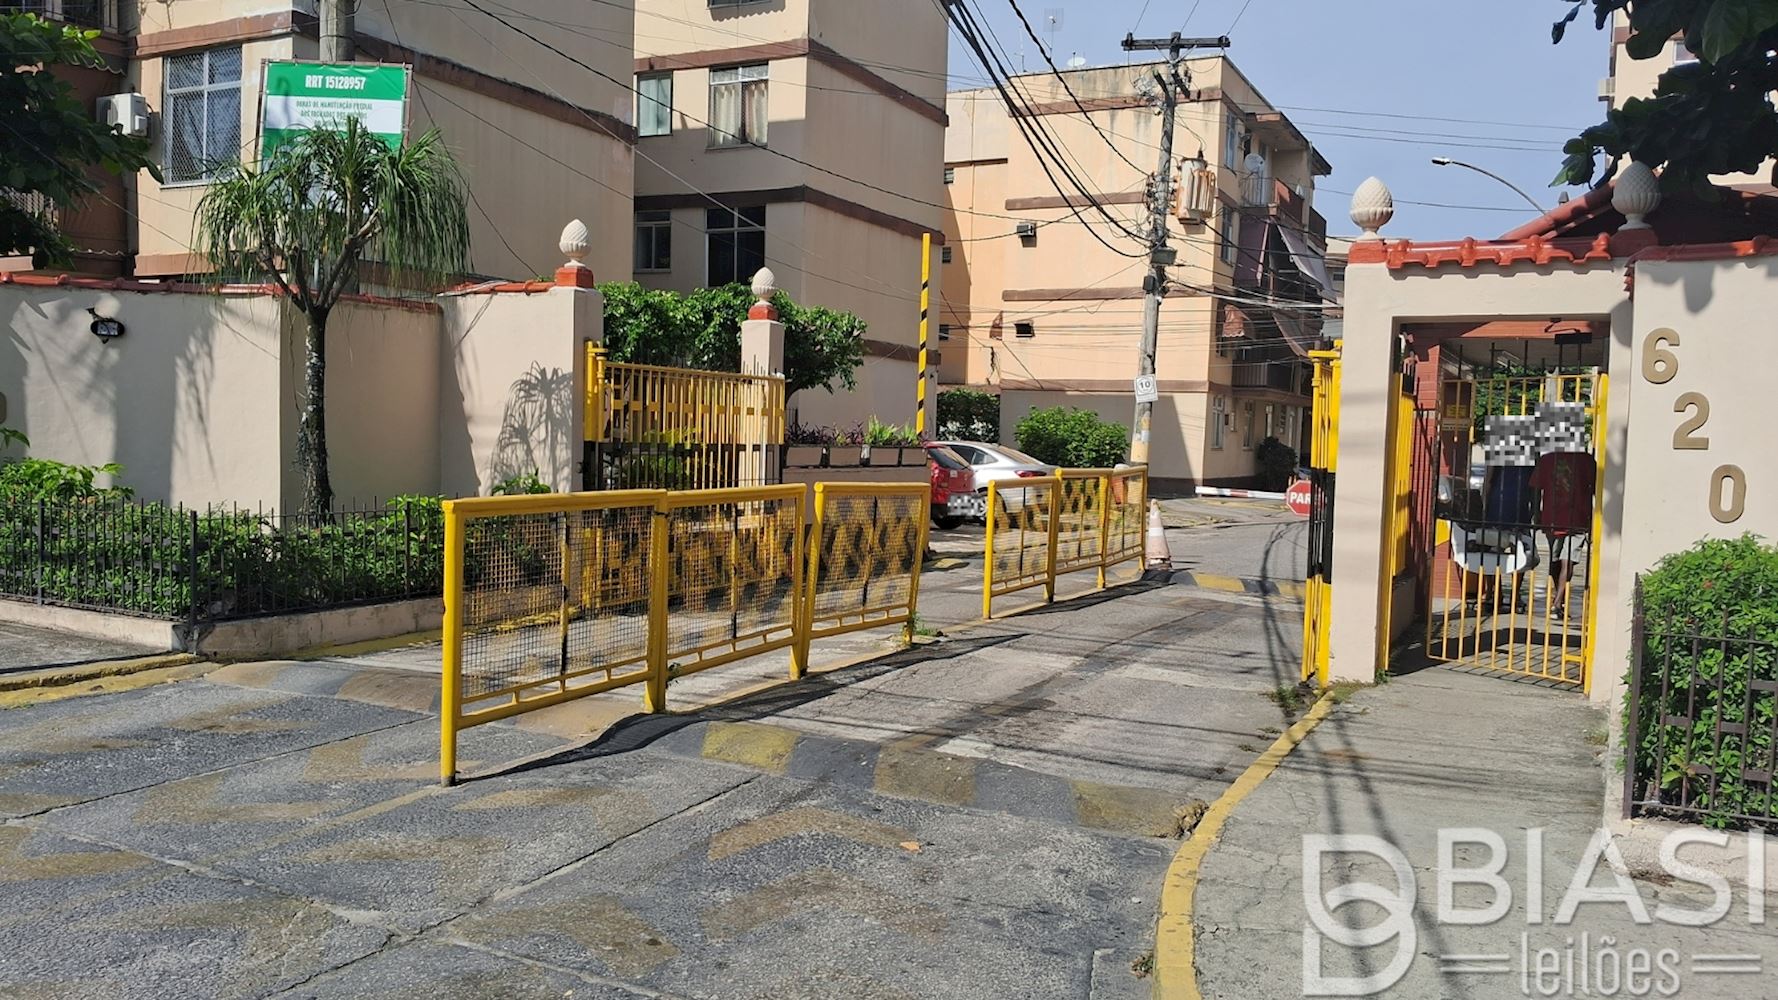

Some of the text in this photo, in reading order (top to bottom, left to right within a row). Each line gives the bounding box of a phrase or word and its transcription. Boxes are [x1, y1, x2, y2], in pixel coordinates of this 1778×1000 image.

[305, 75, 366, 90] RRT 15128957
[1140, 381, 1151, 389] 10
[1290, 491, 1311, 505] PAR
